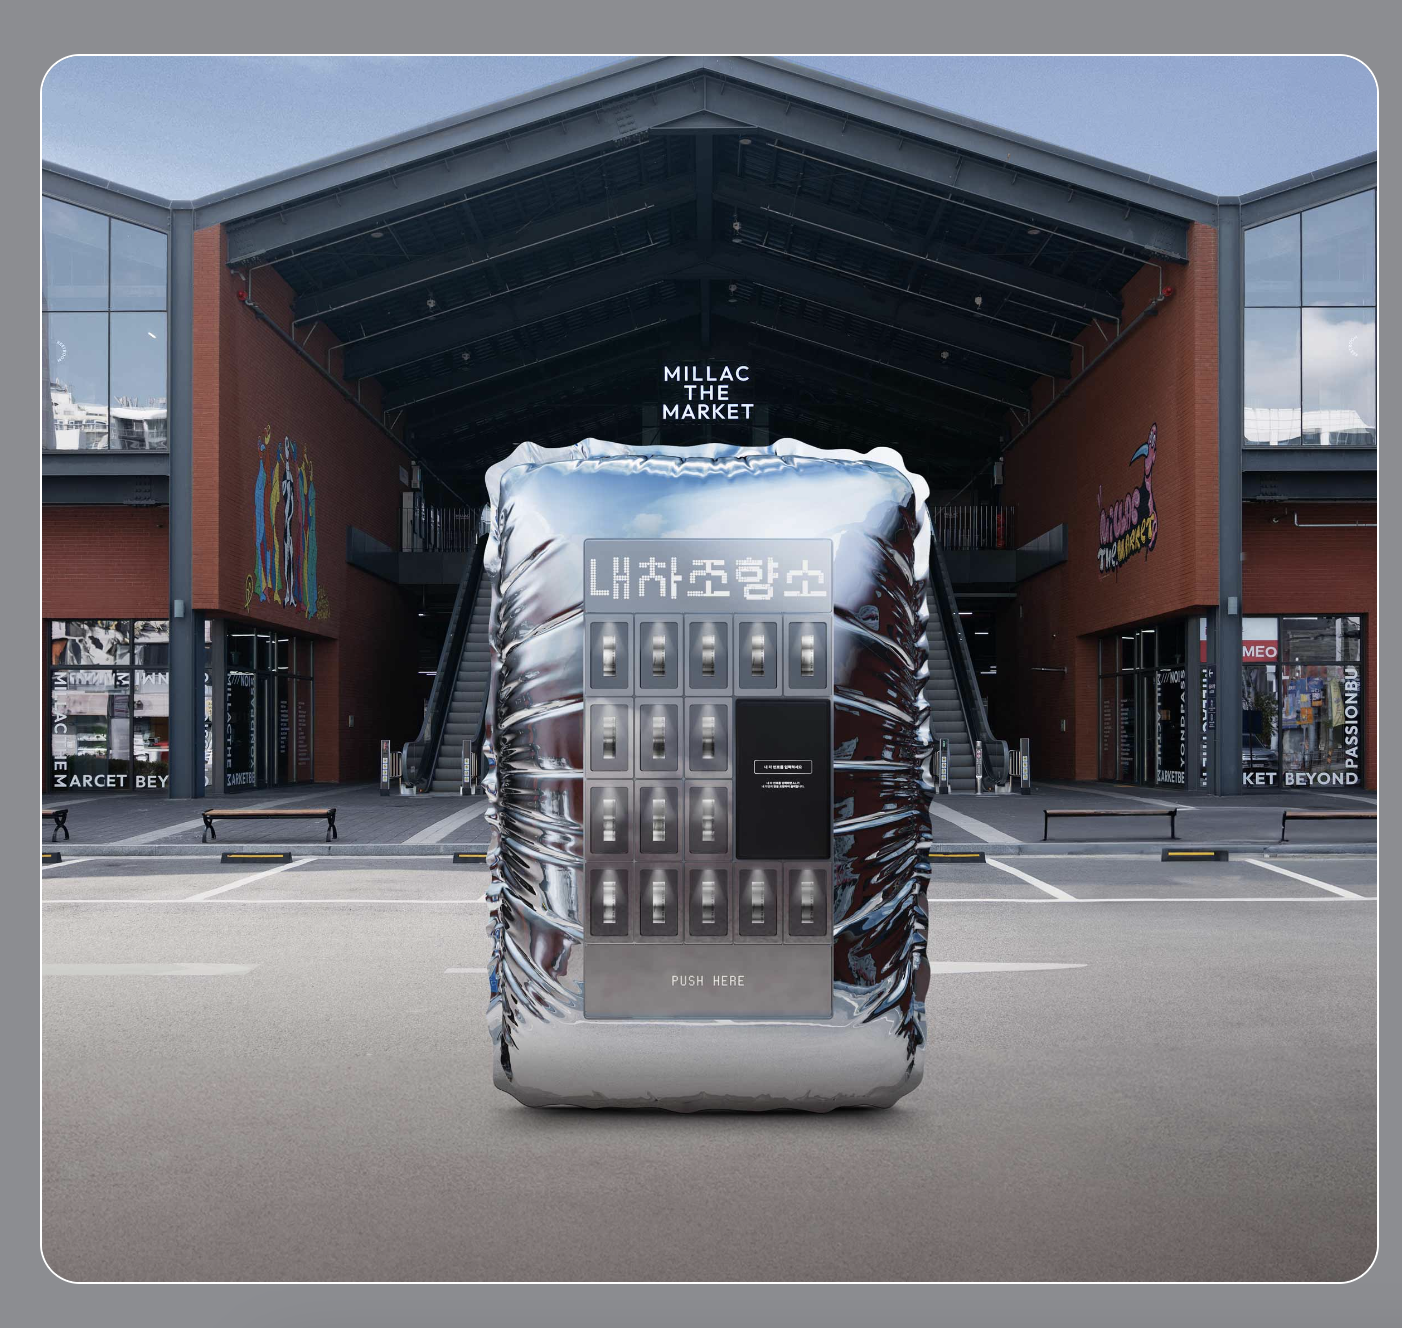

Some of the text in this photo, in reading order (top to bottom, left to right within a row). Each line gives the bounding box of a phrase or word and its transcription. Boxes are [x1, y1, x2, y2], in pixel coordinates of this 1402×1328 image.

[664, 365, 750, 382] MILLAC
[683, 384, 729, 401] THE
[662, 403, 754, 420] MARKET
[589, 556, 828, 601] 내차조향소
[1242, 645, 1278, 658] MEO
[1242, 772, 1359, 786] KET BEYOND
[671, 975, 745, 987] PUSH HERE
